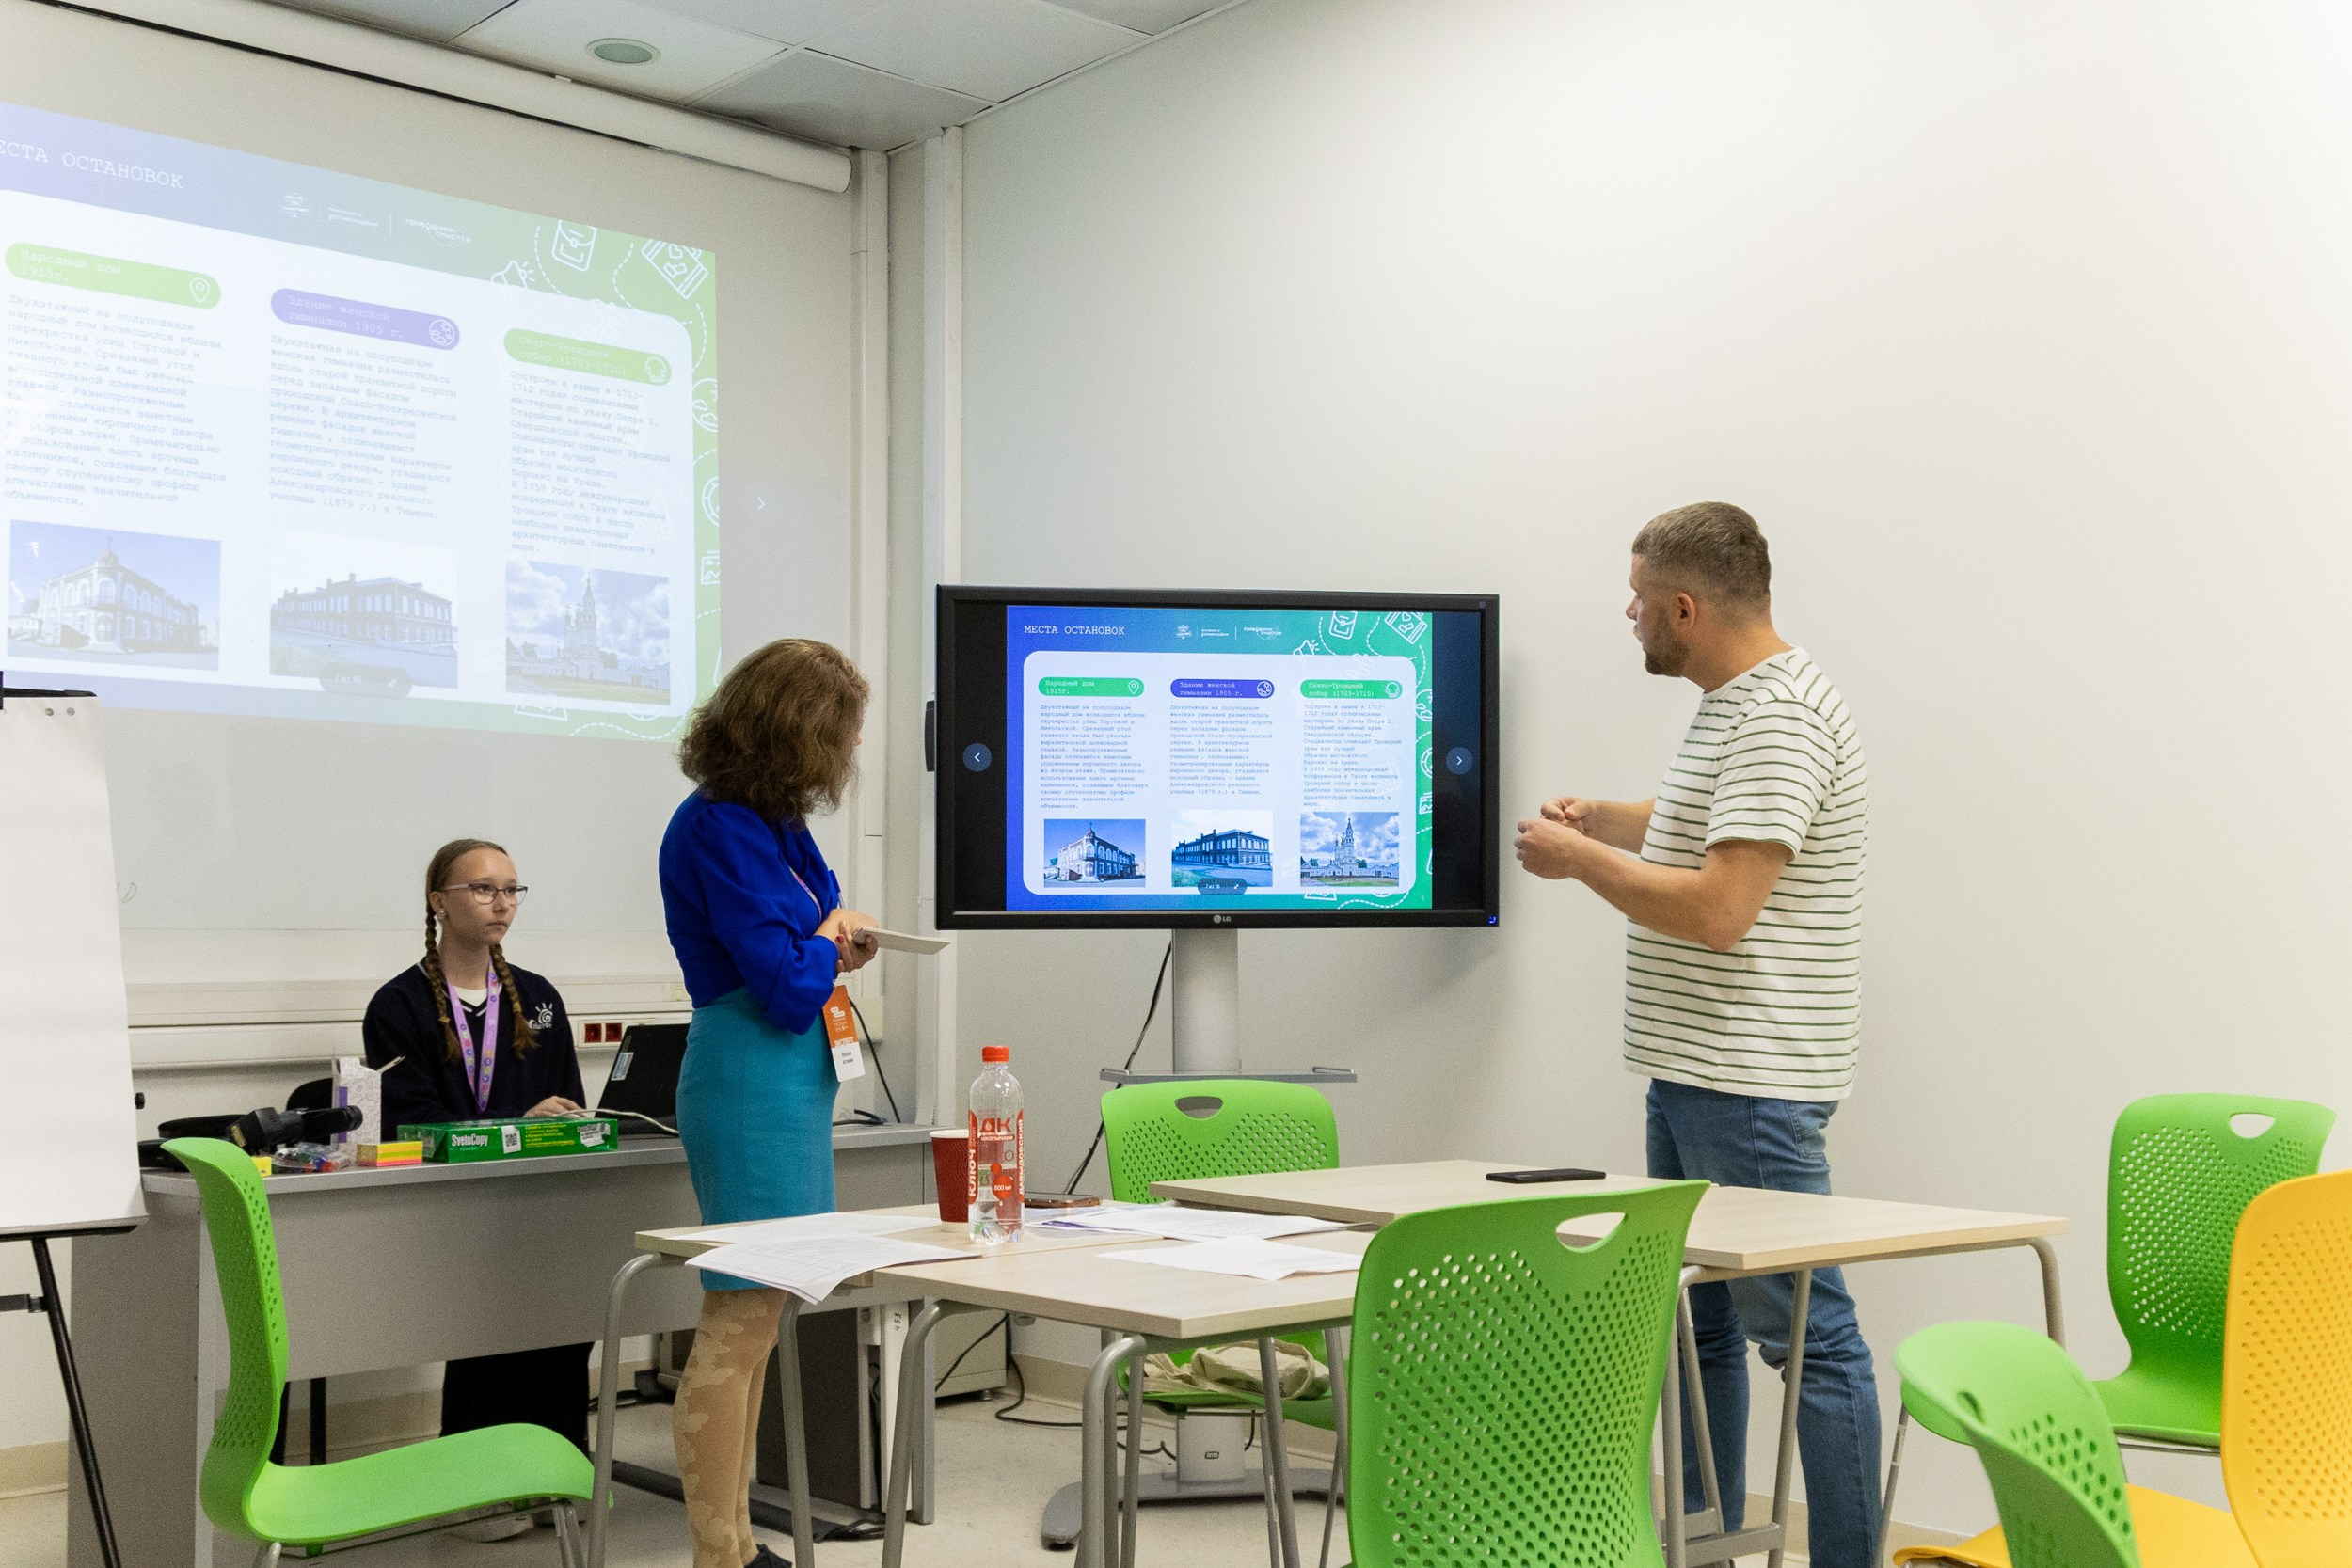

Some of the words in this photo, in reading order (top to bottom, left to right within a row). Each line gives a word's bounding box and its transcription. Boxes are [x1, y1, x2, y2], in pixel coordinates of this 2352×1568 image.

[62, 152, 183, 189] ОСТАНОВОК
[1023, 625, 1057, 634] МЕСТА
[1064, 625, 1125, 635] ОСТАНОВОК
[980, 1117, 1011, 1132] ДК
[452, 1133, 489, 1147] SvetoCopy
